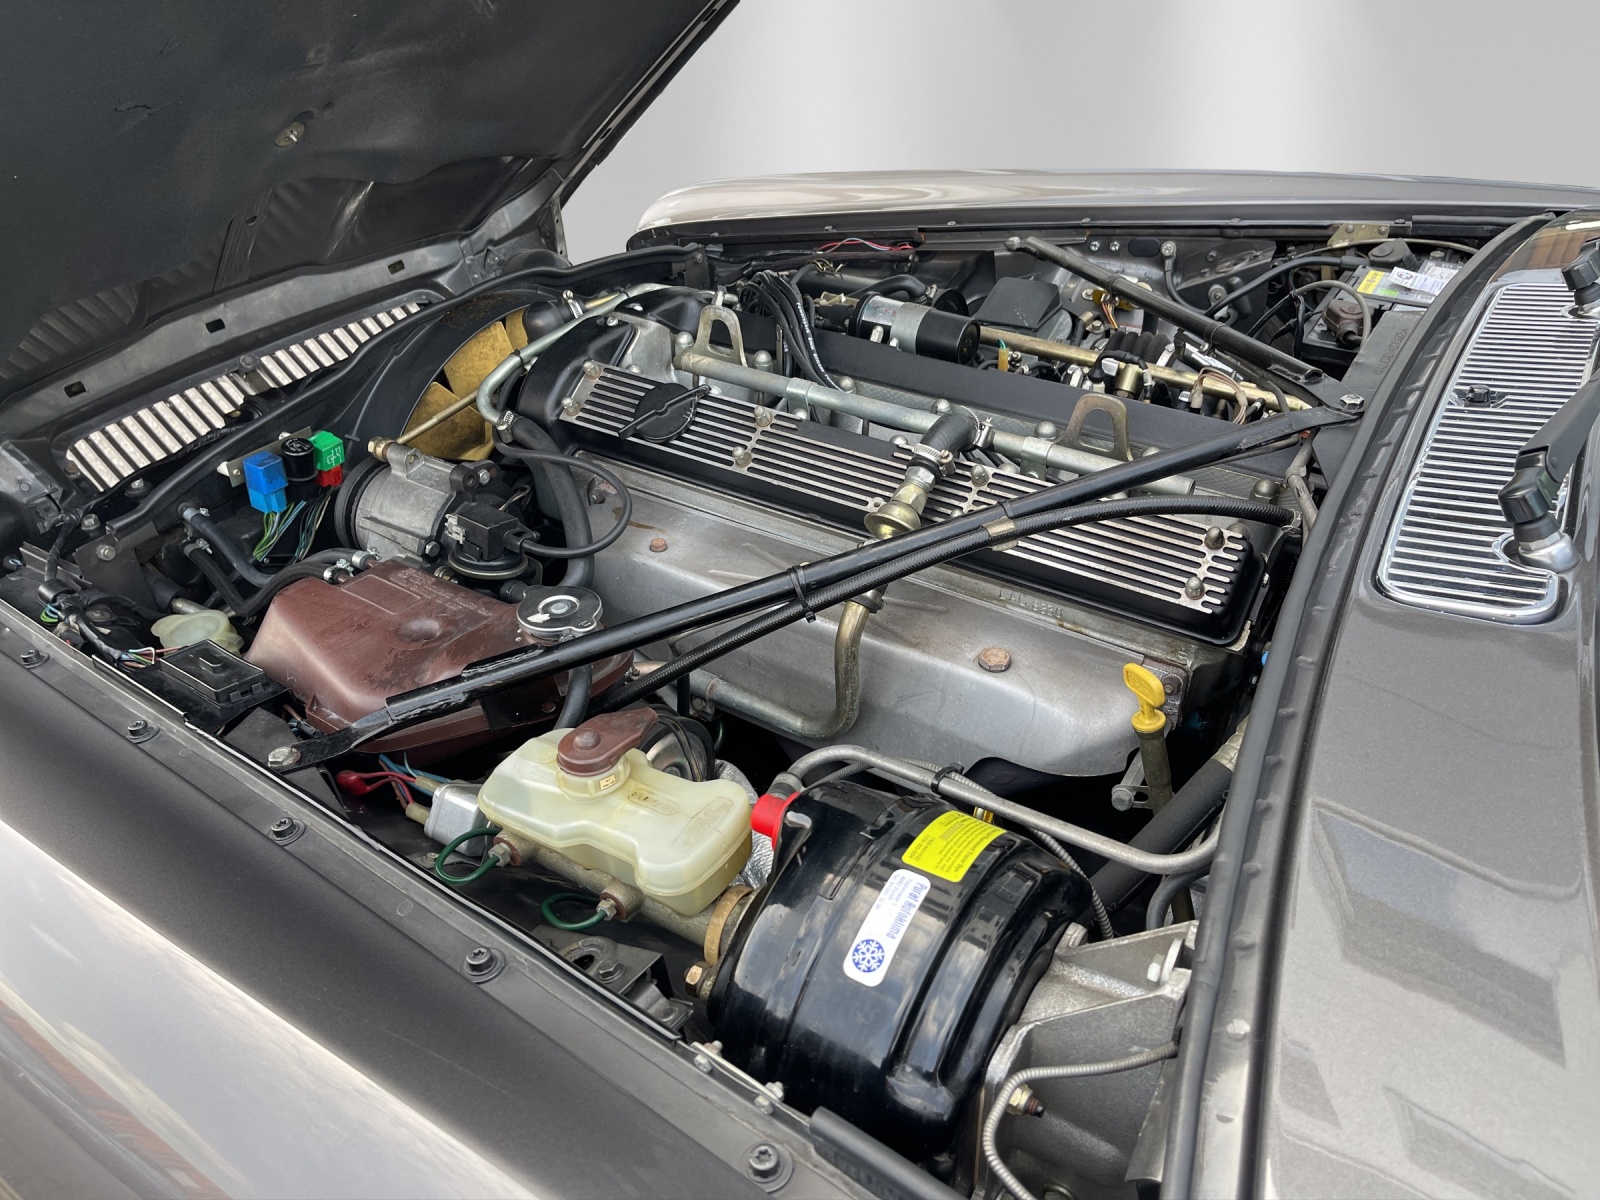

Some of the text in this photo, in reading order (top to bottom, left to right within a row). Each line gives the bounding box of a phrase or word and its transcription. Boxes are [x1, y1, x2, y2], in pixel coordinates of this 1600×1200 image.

[796, 302, 809, 333] Powerspark
[952, 863, 963, 873] Dye
[885, 880, 927, 940] Purat Autoklima
